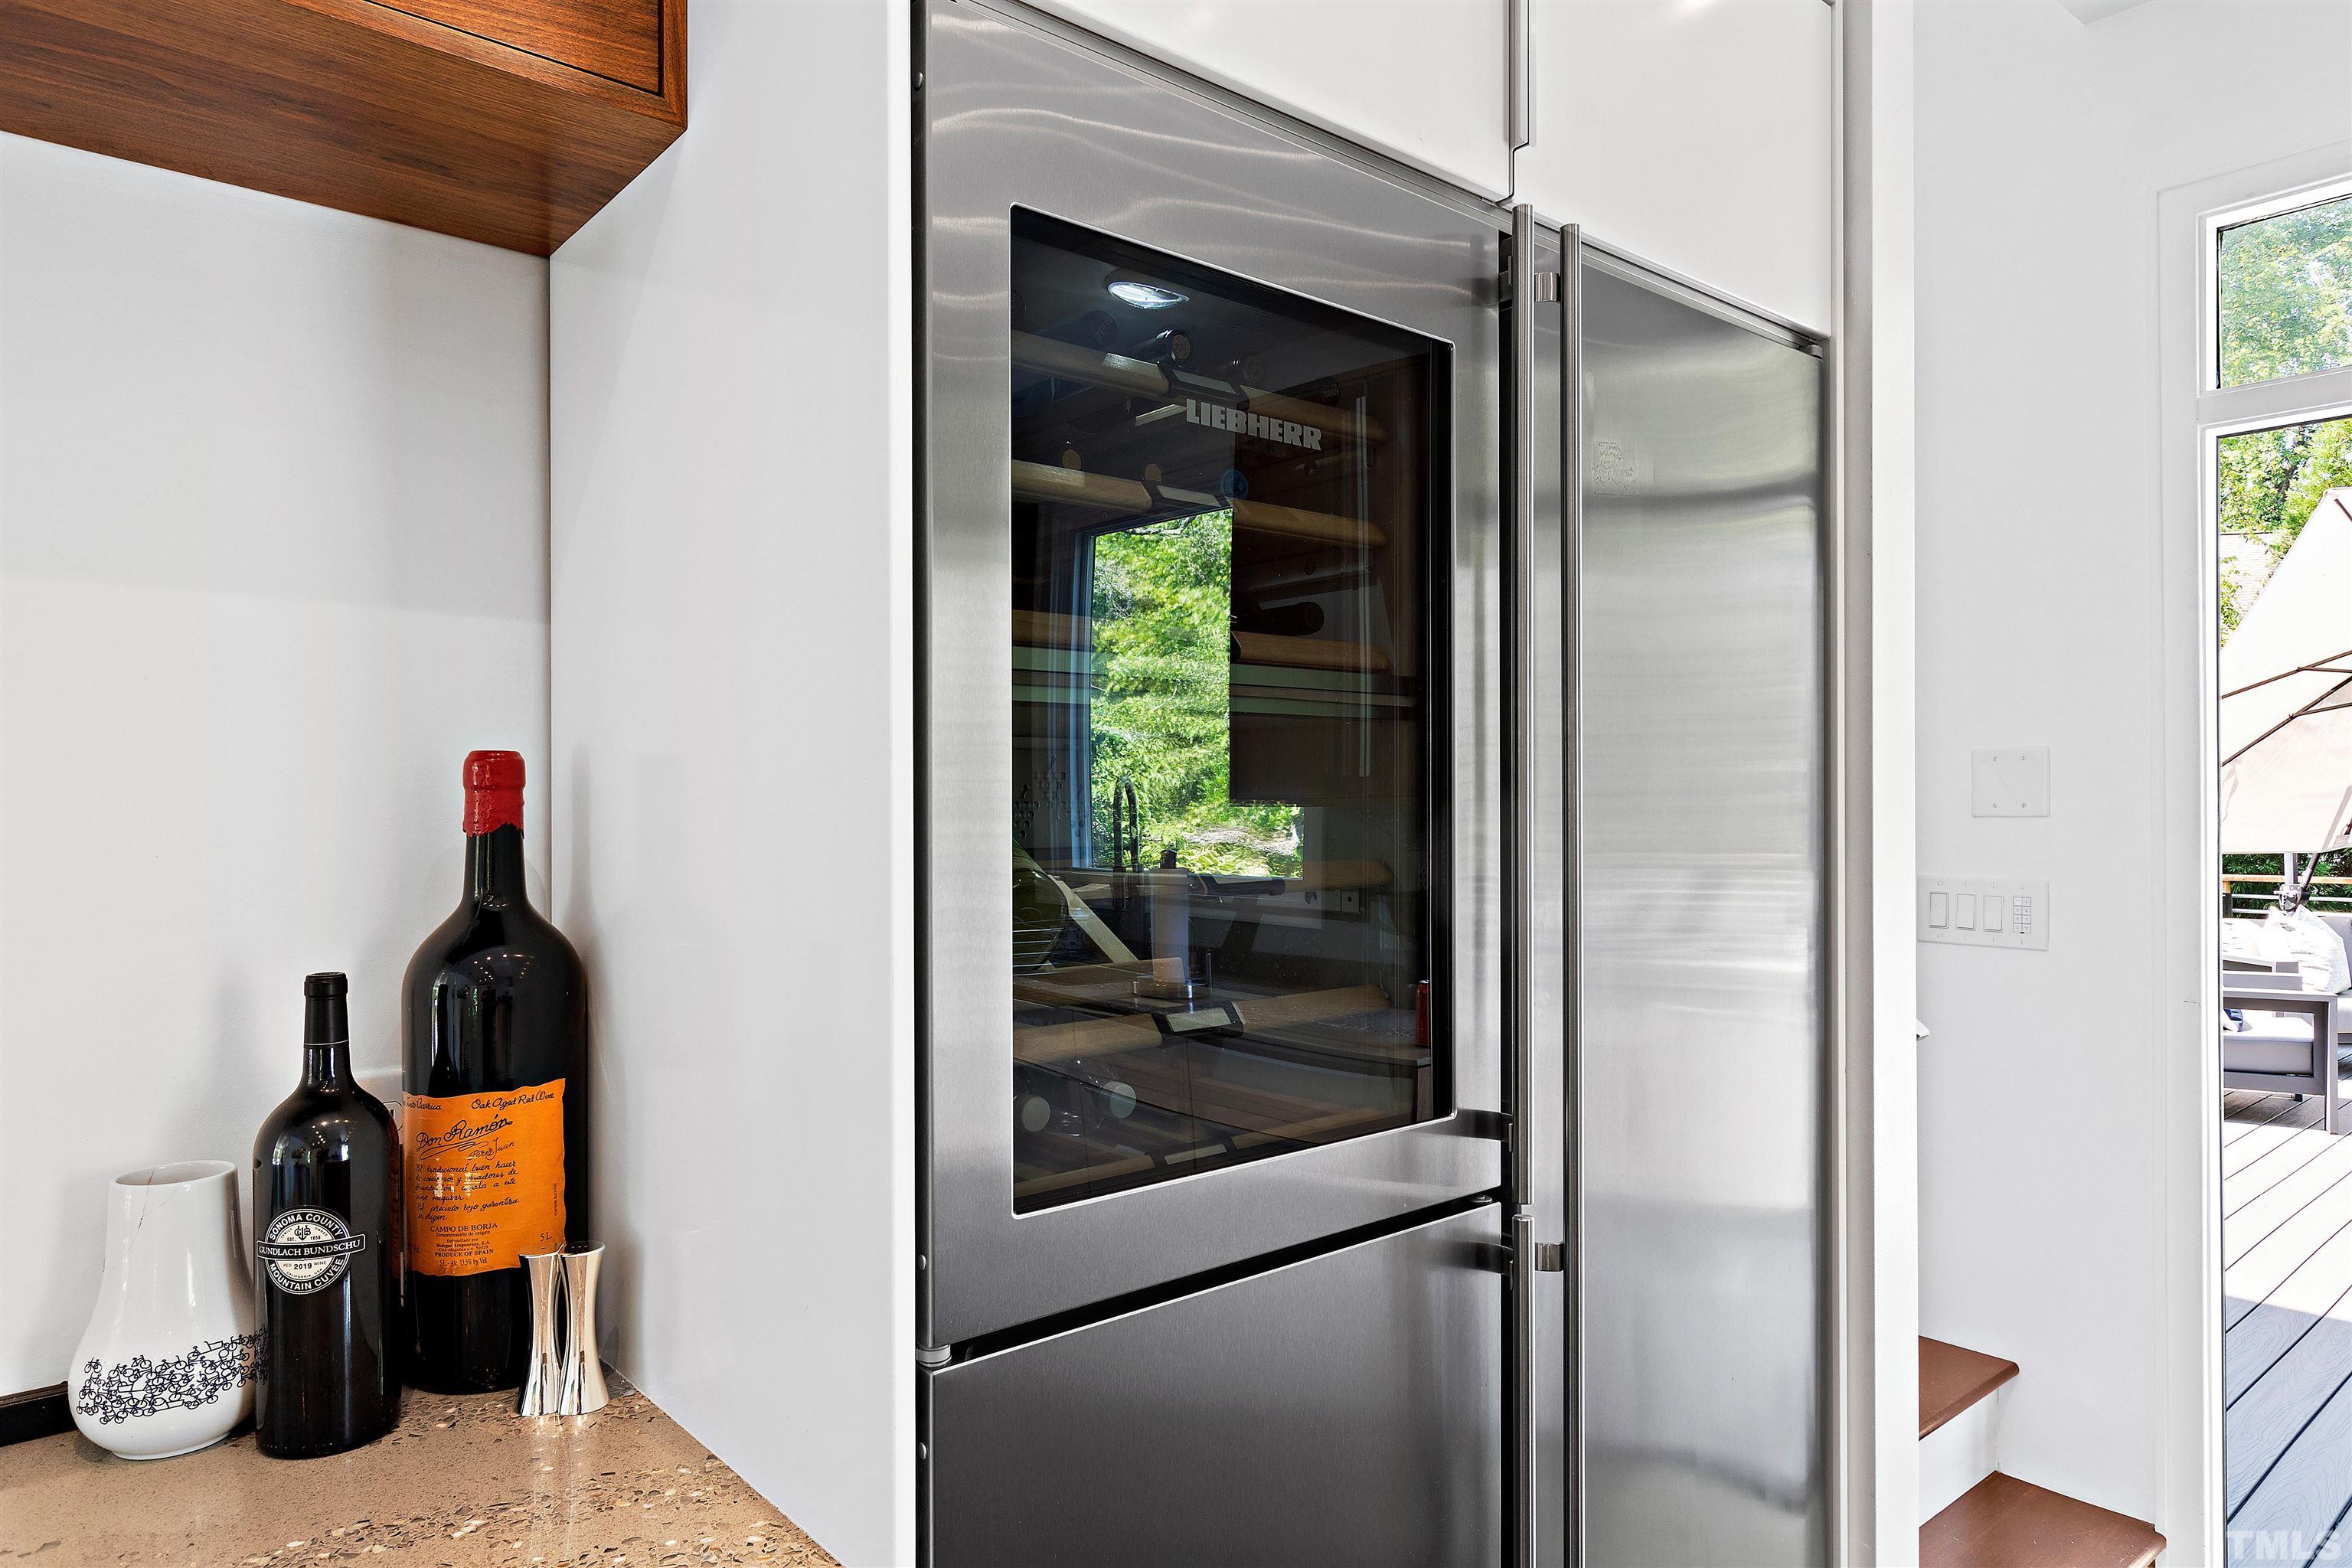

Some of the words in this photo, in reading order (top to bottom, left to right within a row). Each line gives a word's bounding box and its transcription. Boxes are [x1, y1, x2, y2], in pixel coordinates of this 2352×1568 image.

[1186, 398, 1321, 451] LIEBHERR
[416, 1097, 443, 1110] Barrica
[471, 1099, 491, 1109] Oak
[492, 1097, 517, 1111] Aged
[518, 1094, 534, 1104] Red
[535, 1090, 555, 1101] Wine
[416, 1132, 442, 1152] Don
[443, 1113, 514, 1142] Ramón
[485, 1136, 515, 1161] Juan
[495, 1160, 516, 1169] hacer
[455, 1177, 463, 1187] y
[270, 1214, 303, 1240] SONOMA
[305, 1213, 344, 1236] COUNTY
[471, 1223, 498, 1231] BORJA
[259, 1246, 302, 1256] GUNDLACH
[304, 1240, 361, 1256] BUNDSCHU
[270, 1263, 312, 1291] MOUNTAIN
